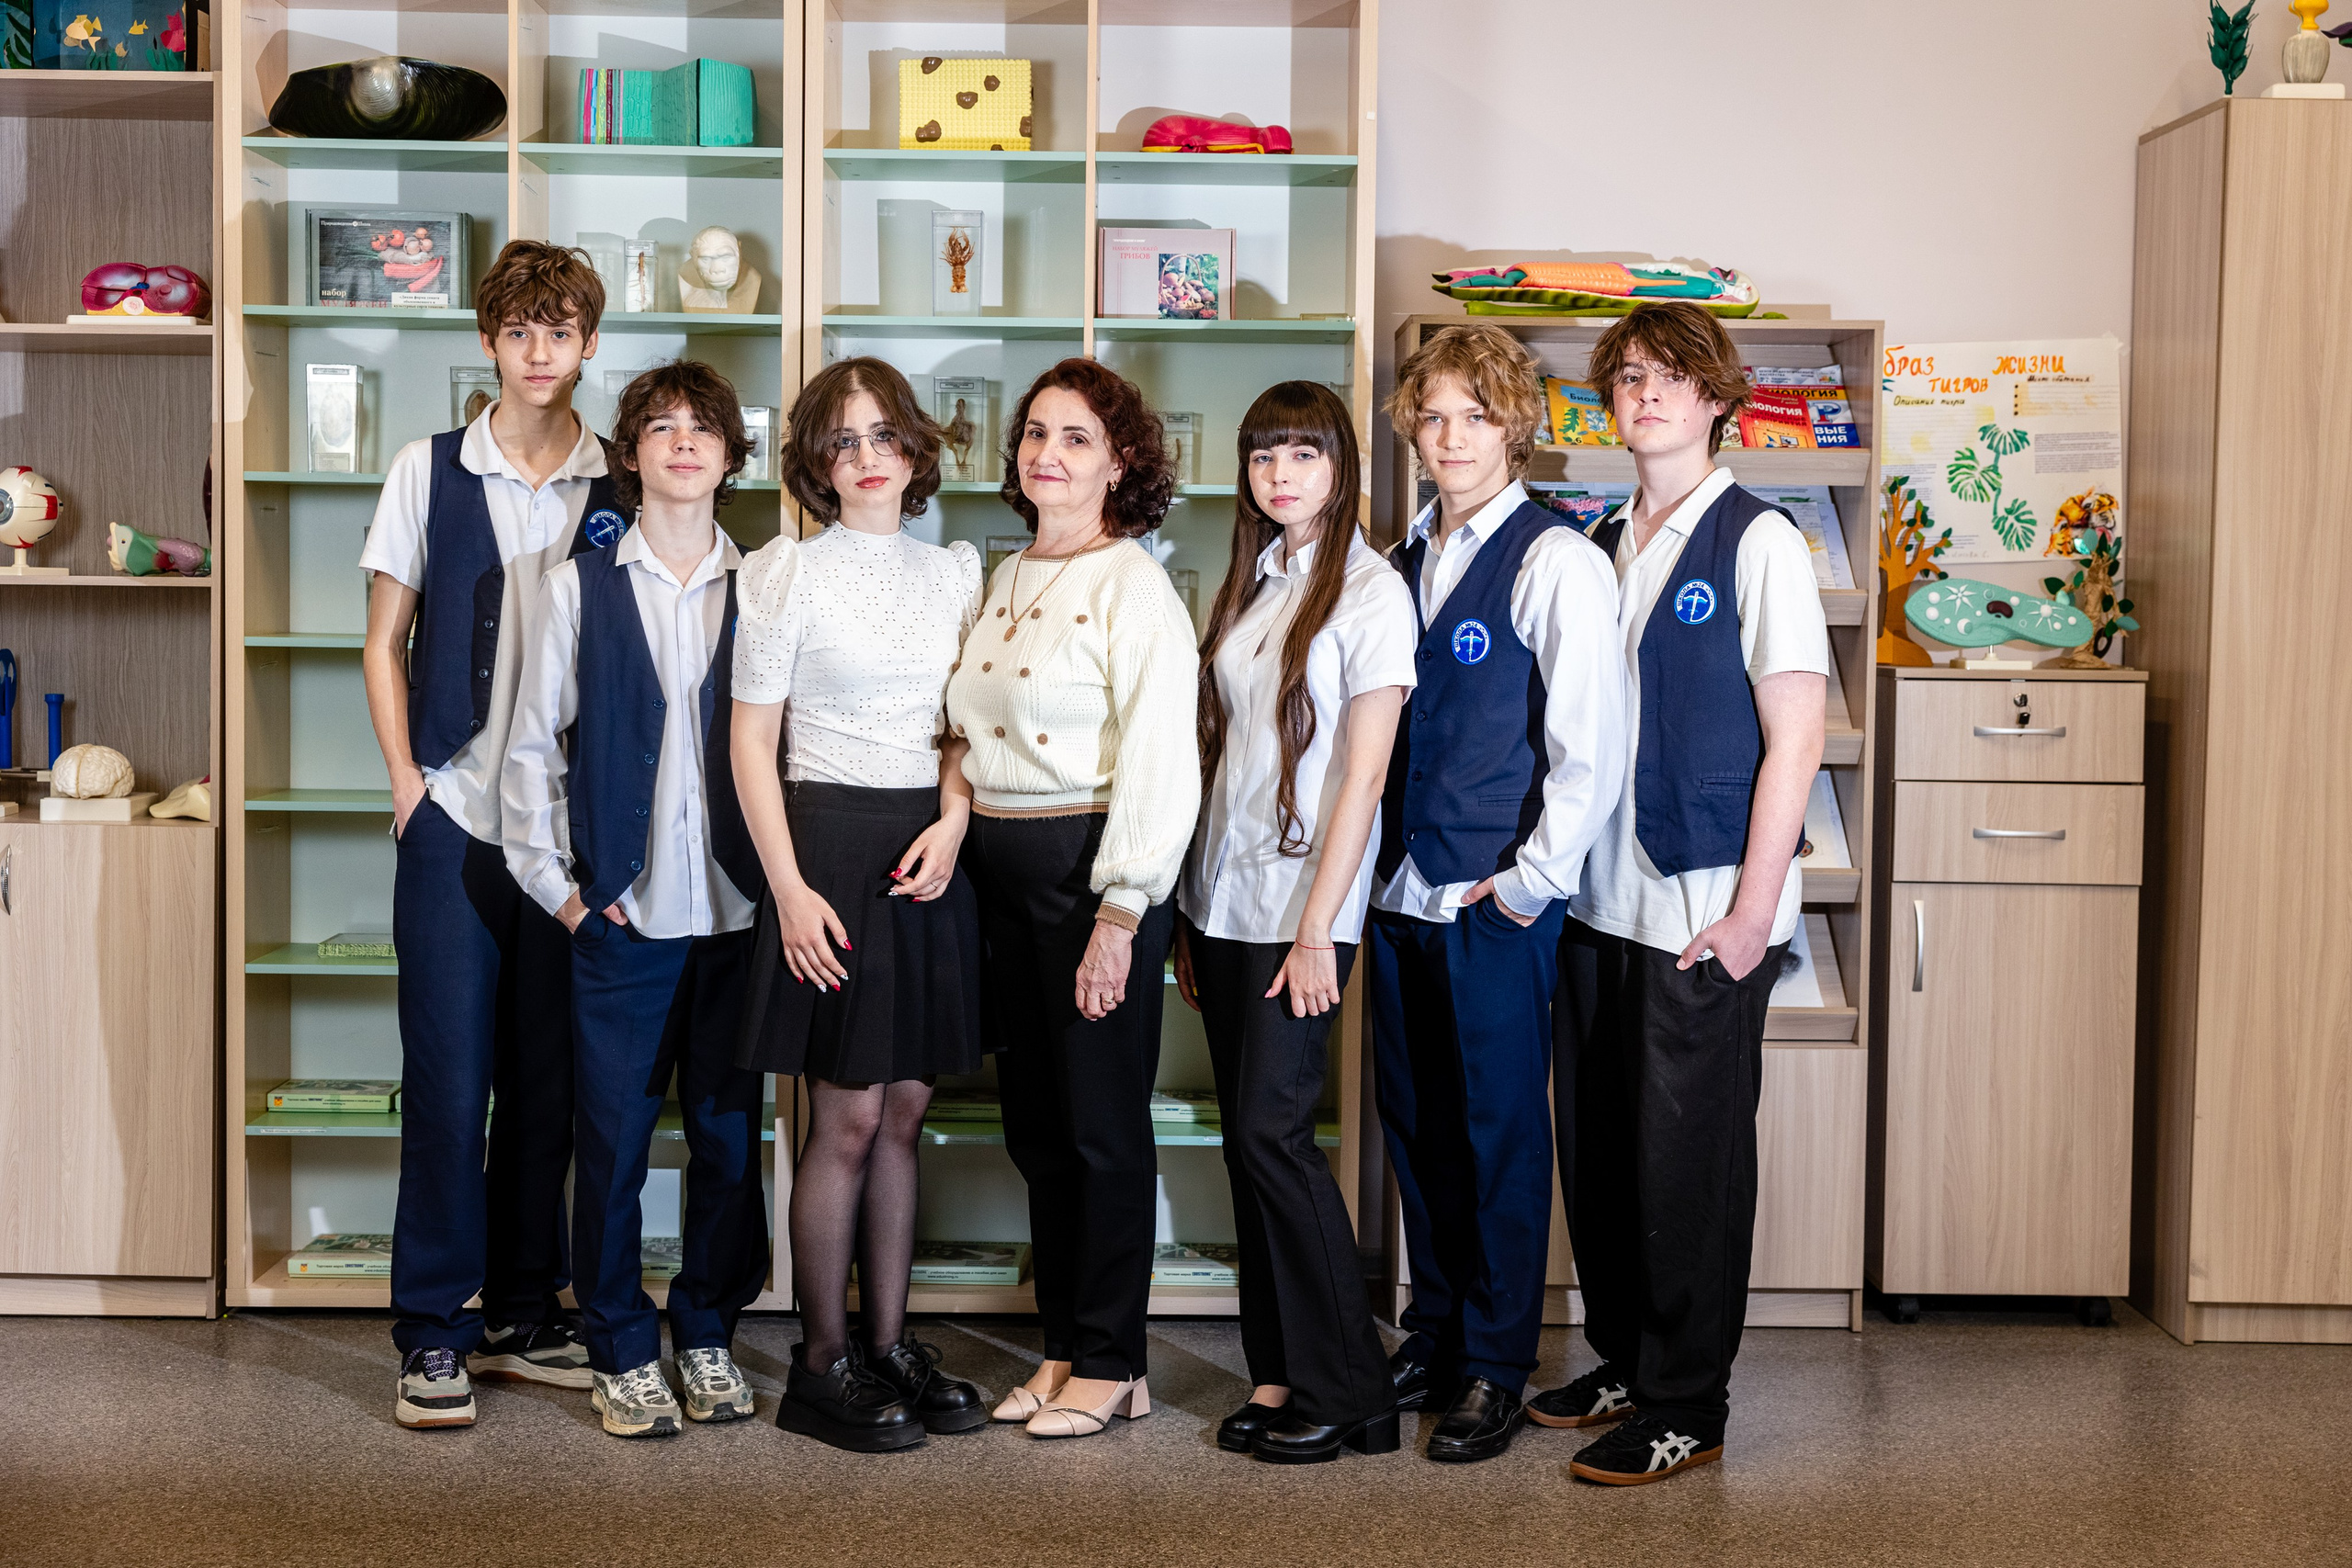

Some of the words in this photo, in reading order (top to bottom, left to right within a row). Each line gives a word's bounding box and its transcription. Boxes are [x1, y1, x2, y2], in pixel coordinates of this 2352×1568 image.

[322, 288, 346, 298] набор
[1570, 393, 1599, 402] Биол
[1894, 395, 1935, 406] Описание
[1746, 401, 1803, 416] ИОЛОГИЯ
[1815, 426, 1847, 434] ВЫЕ
[1678, 585, 1690, 606] ШКОЛА
[1454, 626, 1465, 648] ШКОЛА
